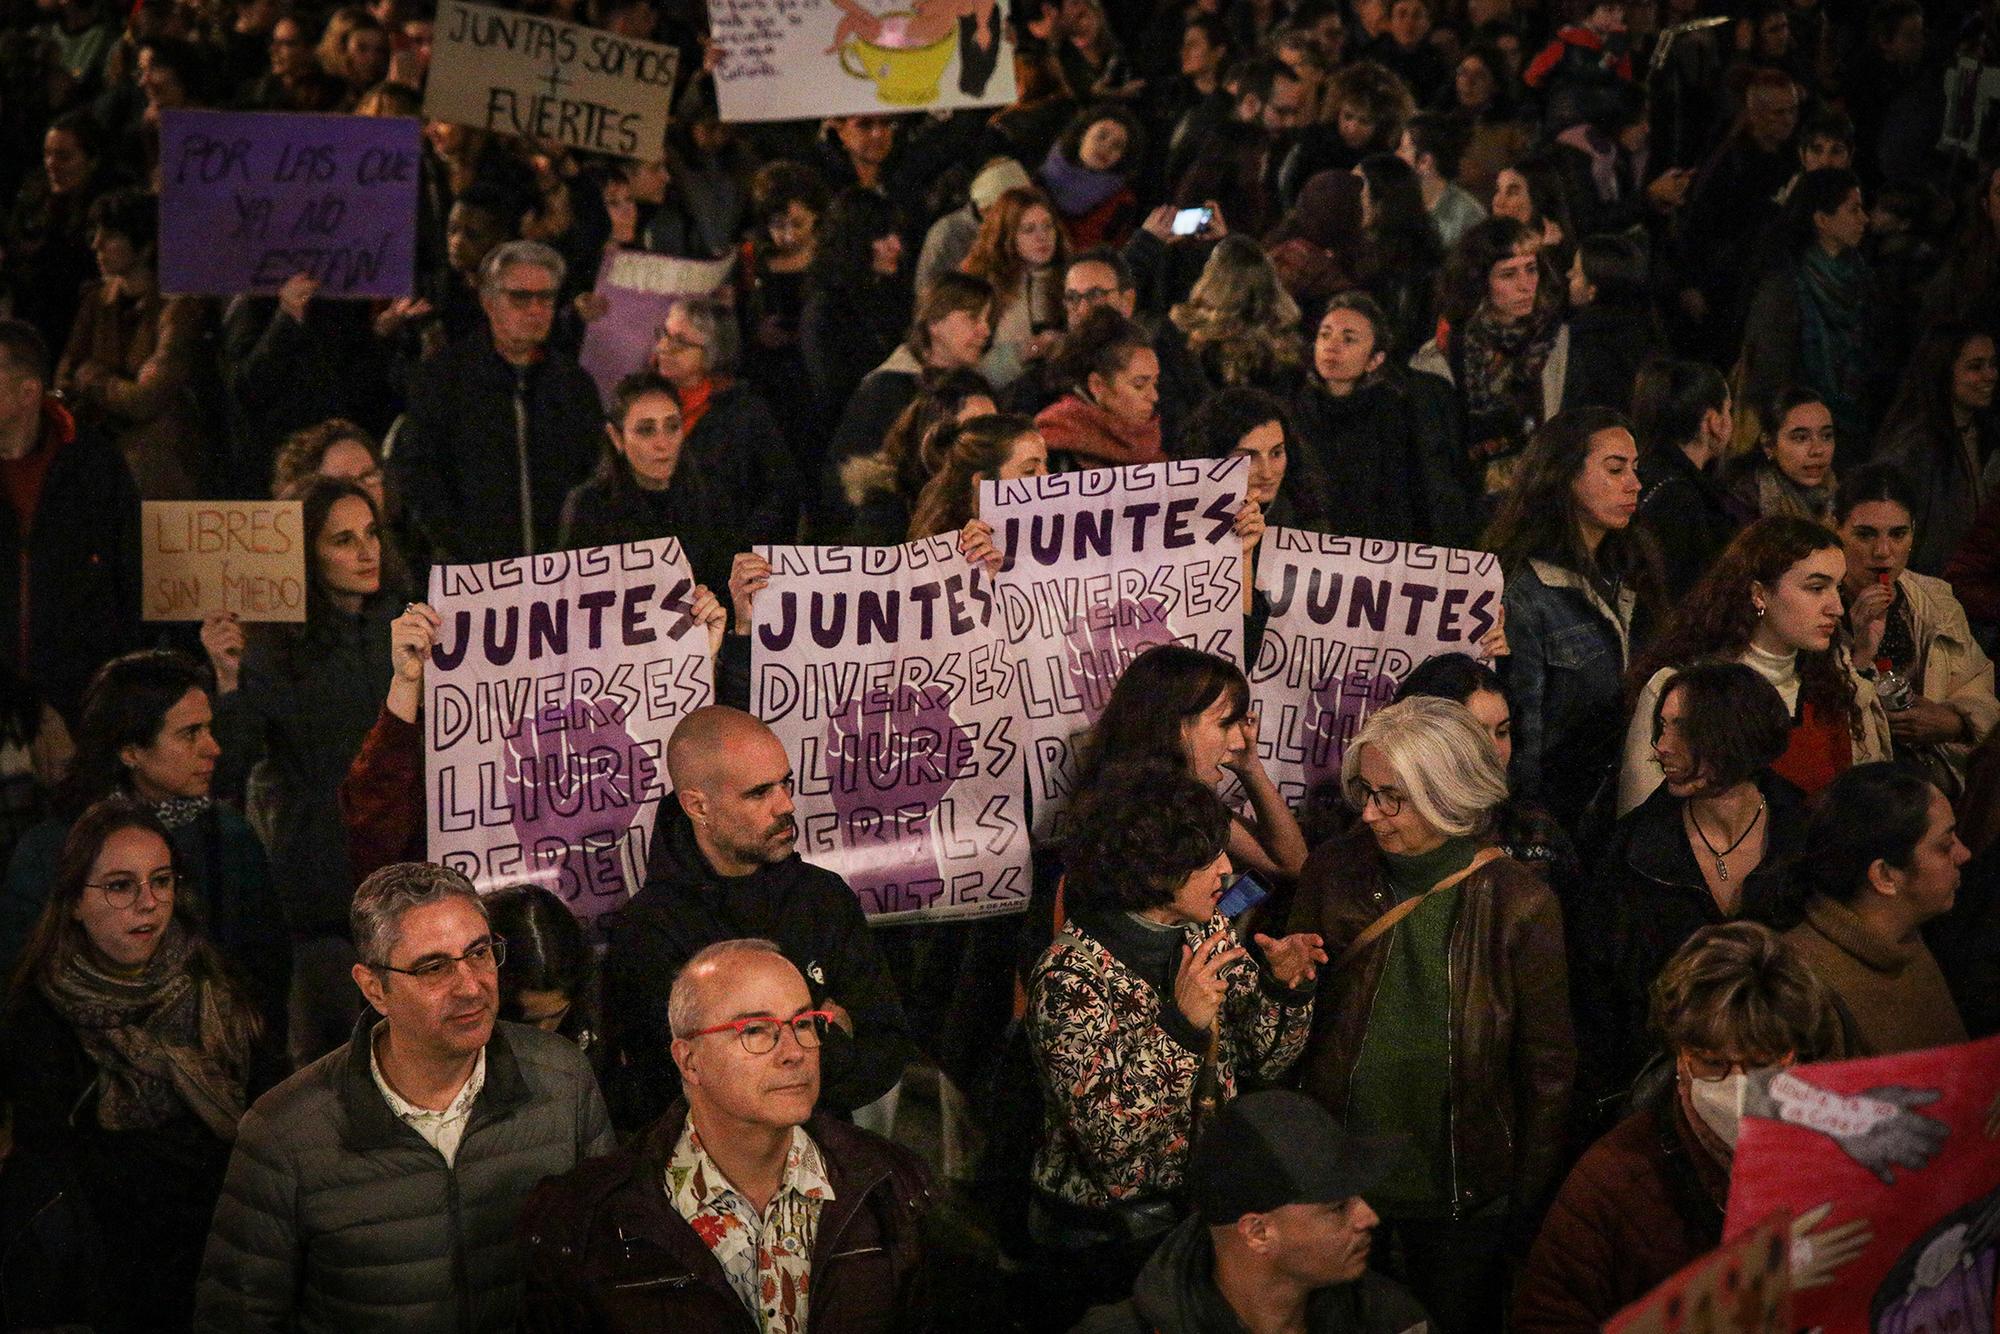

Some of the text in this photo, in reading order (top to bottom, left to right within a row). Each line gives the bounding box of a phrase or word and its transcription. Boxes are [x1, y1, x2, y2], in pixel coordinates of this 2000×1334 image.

[450, 7, 677, 87] JUNTAS SOMOS
[486, 86, 641, 151] FUERTES
[177, 134, 251, 185] POR
[274, 143, 338, 184] LAS
[230, 193, 345, 240] YA NO
[157, 509, 292, 554] LIBRES
[1001, 492, 1238, 572] JUNTES
[154, 560, 300, 613] SIN MIEDO
[431, 577, 694, 671] JUNTES
[757, 566, 992, 651] JUNTES
[1000, 556, 1241, 645] DIVERSES
[1267, 563, 1495, 643] JUNTES
[434, 655, 710, 751] DIVERSES
[758, 639, 1015, 724] DIVERSES
[1250, 627, 1414, 702] DIVER
[438, 739, 666, 832] LLIURE
[788, 717, 1016, 796] LIURES
